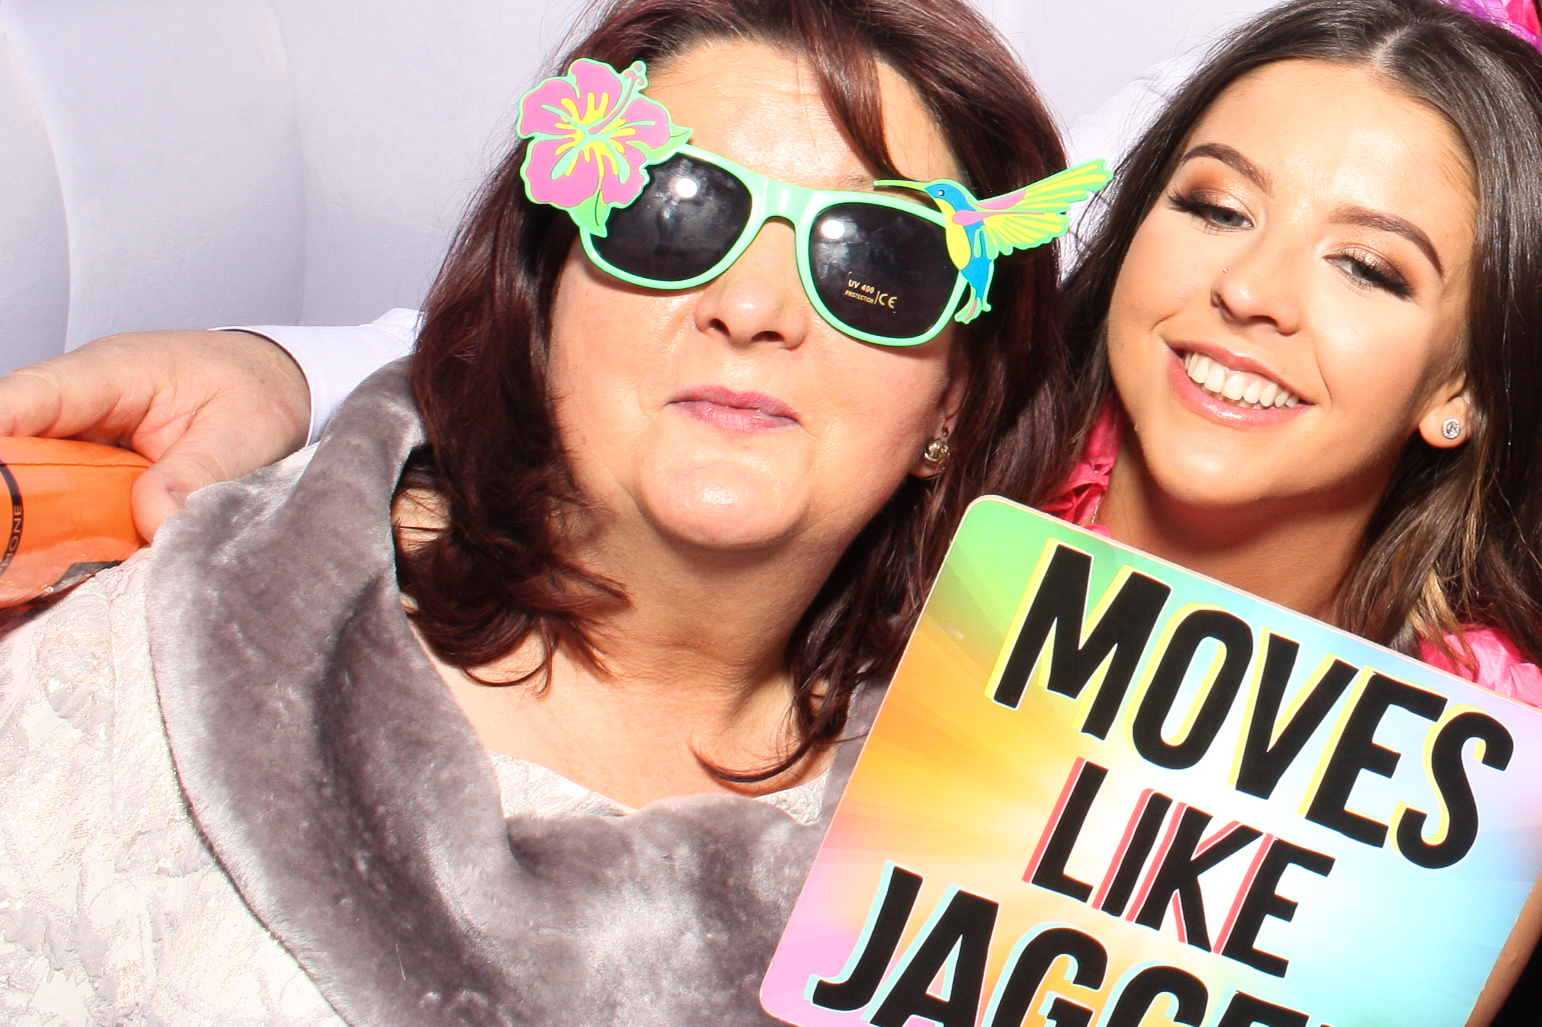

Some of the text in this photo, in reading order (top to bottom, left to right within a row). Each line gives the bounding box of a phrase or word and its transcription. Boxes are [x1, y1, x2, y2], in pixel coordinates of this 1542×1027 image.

[844, 289, 875, 304] PROTECTION
[848, 279, 875, 293] UV 400
[985, 537, 1516, 869] MOVES
[1021, 756, 1337, 979] LIKE
